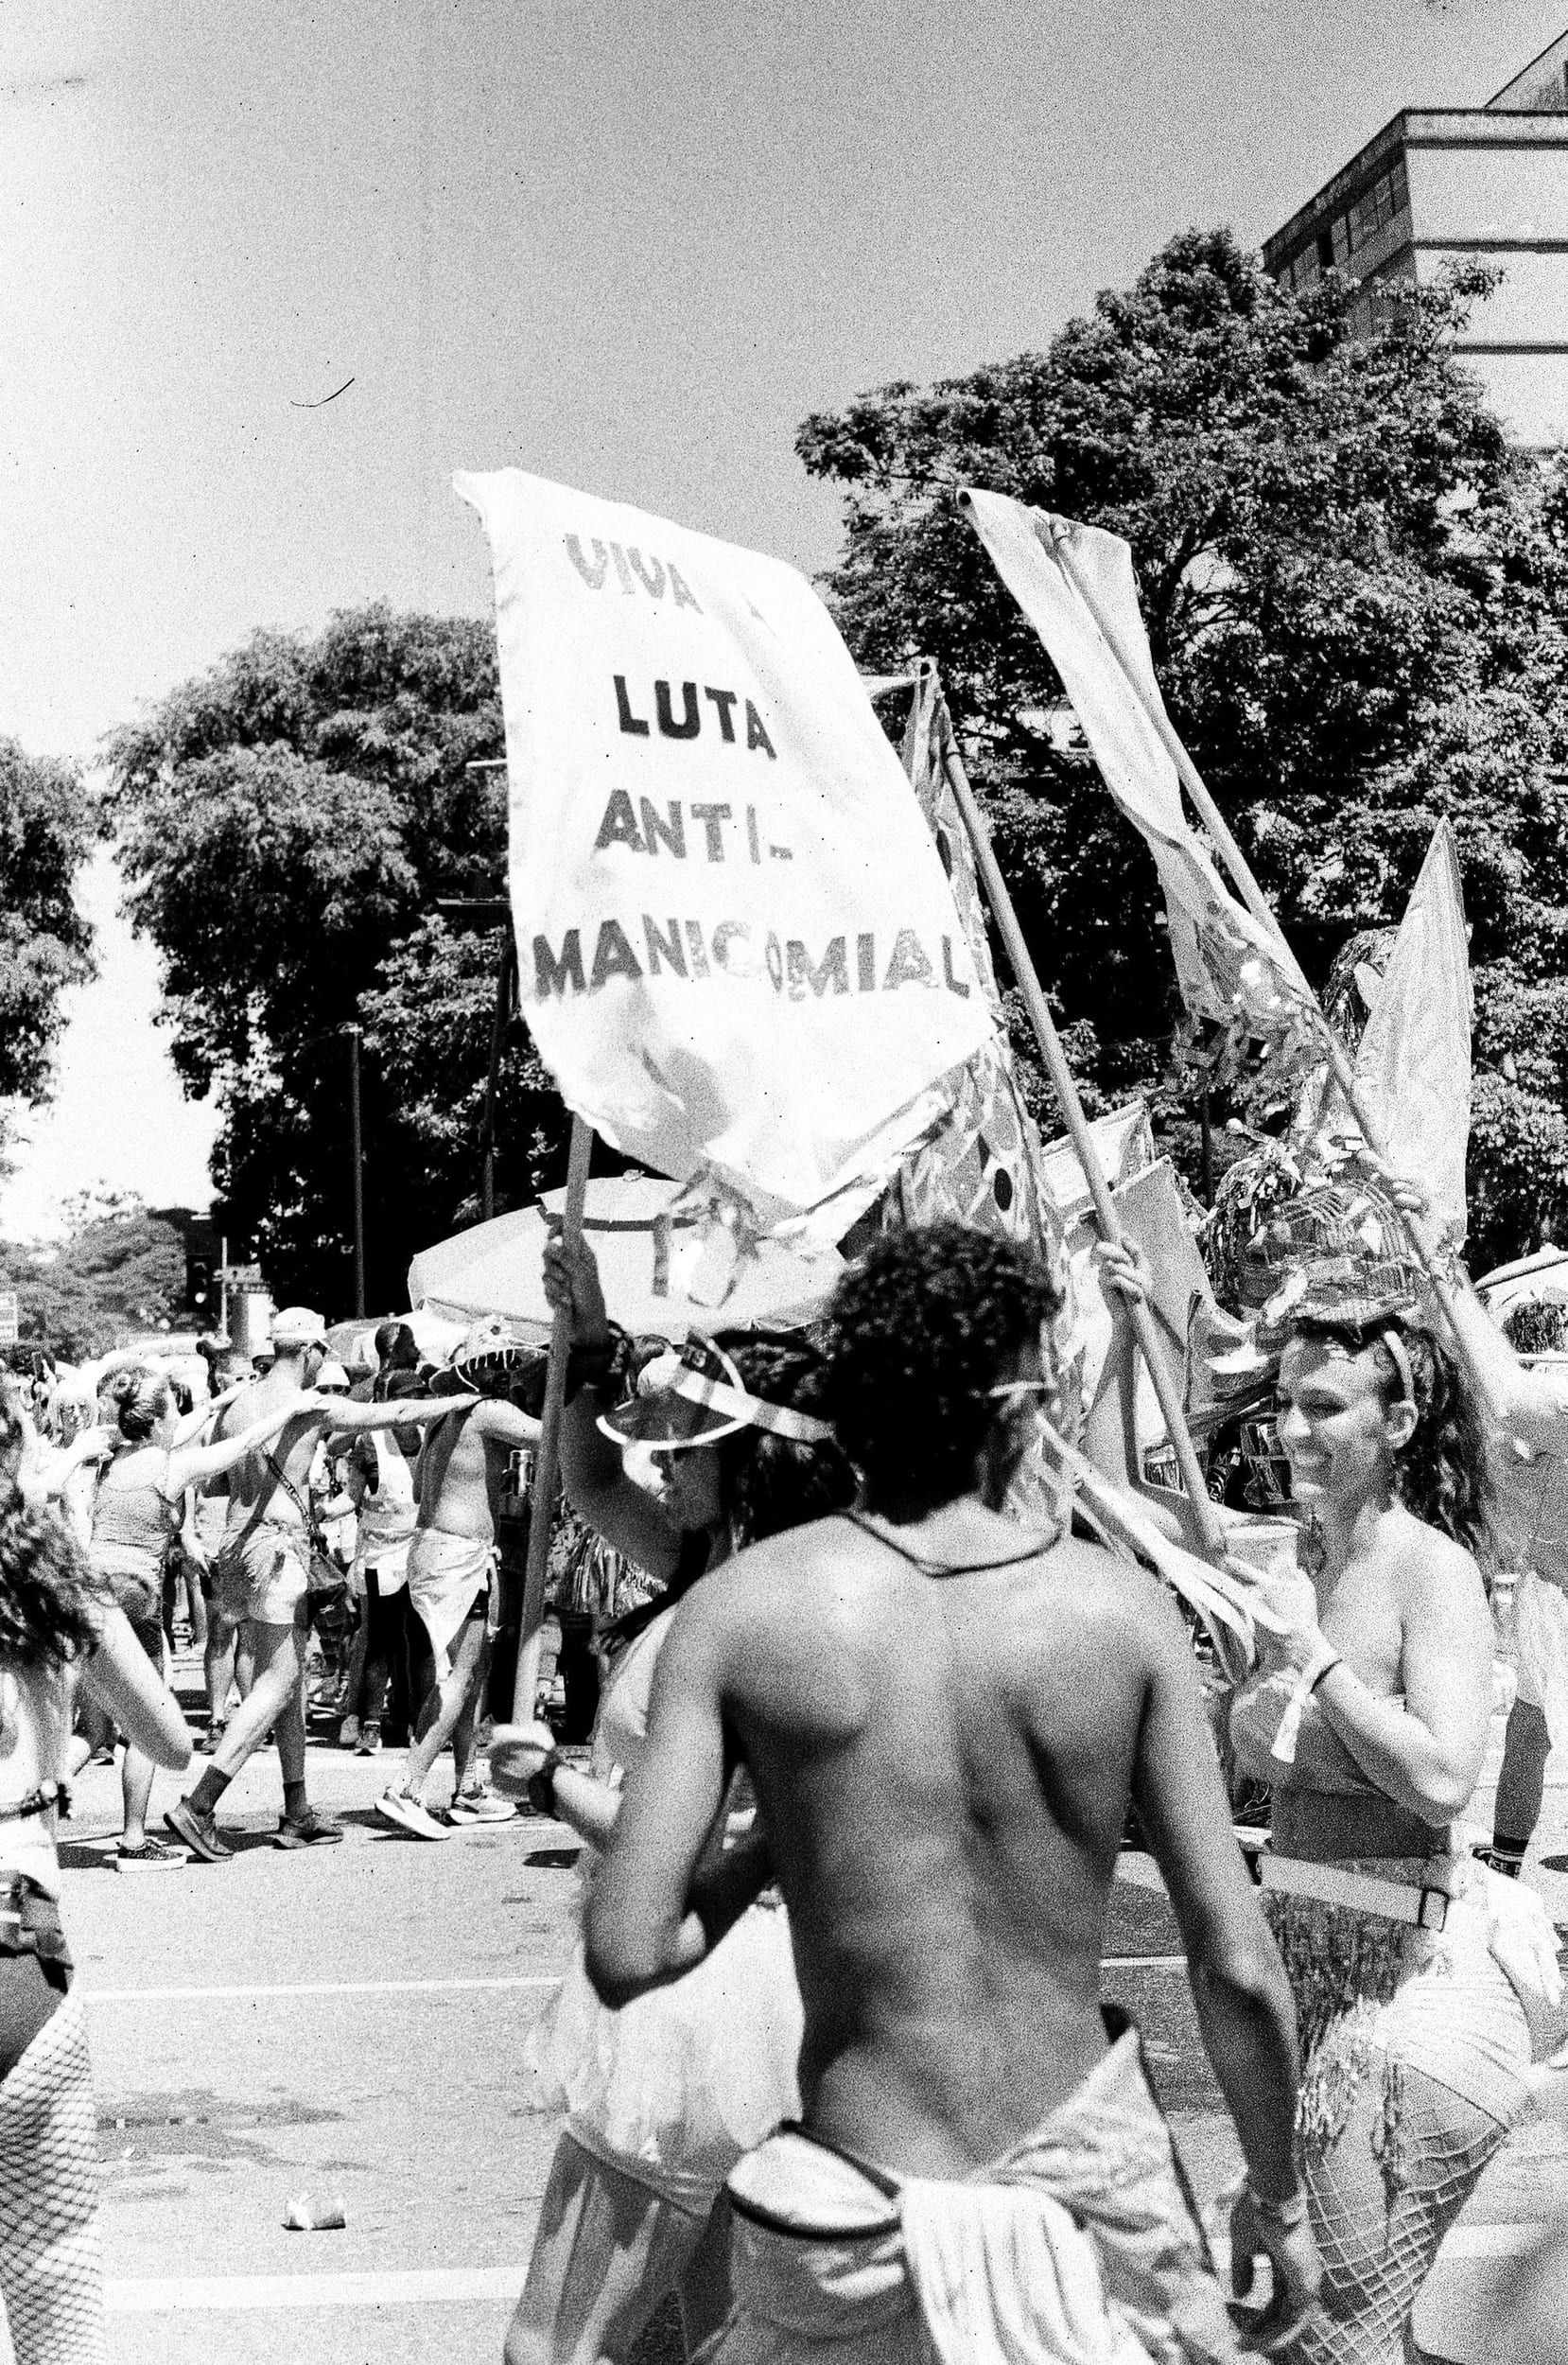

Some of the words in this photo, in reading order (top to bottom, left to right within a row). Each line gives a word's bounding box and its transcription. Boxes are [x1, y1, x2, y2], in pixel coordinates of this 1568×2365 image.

[565, 533, 704, 615] VIVA
[613, 674, 777, 761] LUTA
[531, 913, 971, 1007] MANICOMIAL
